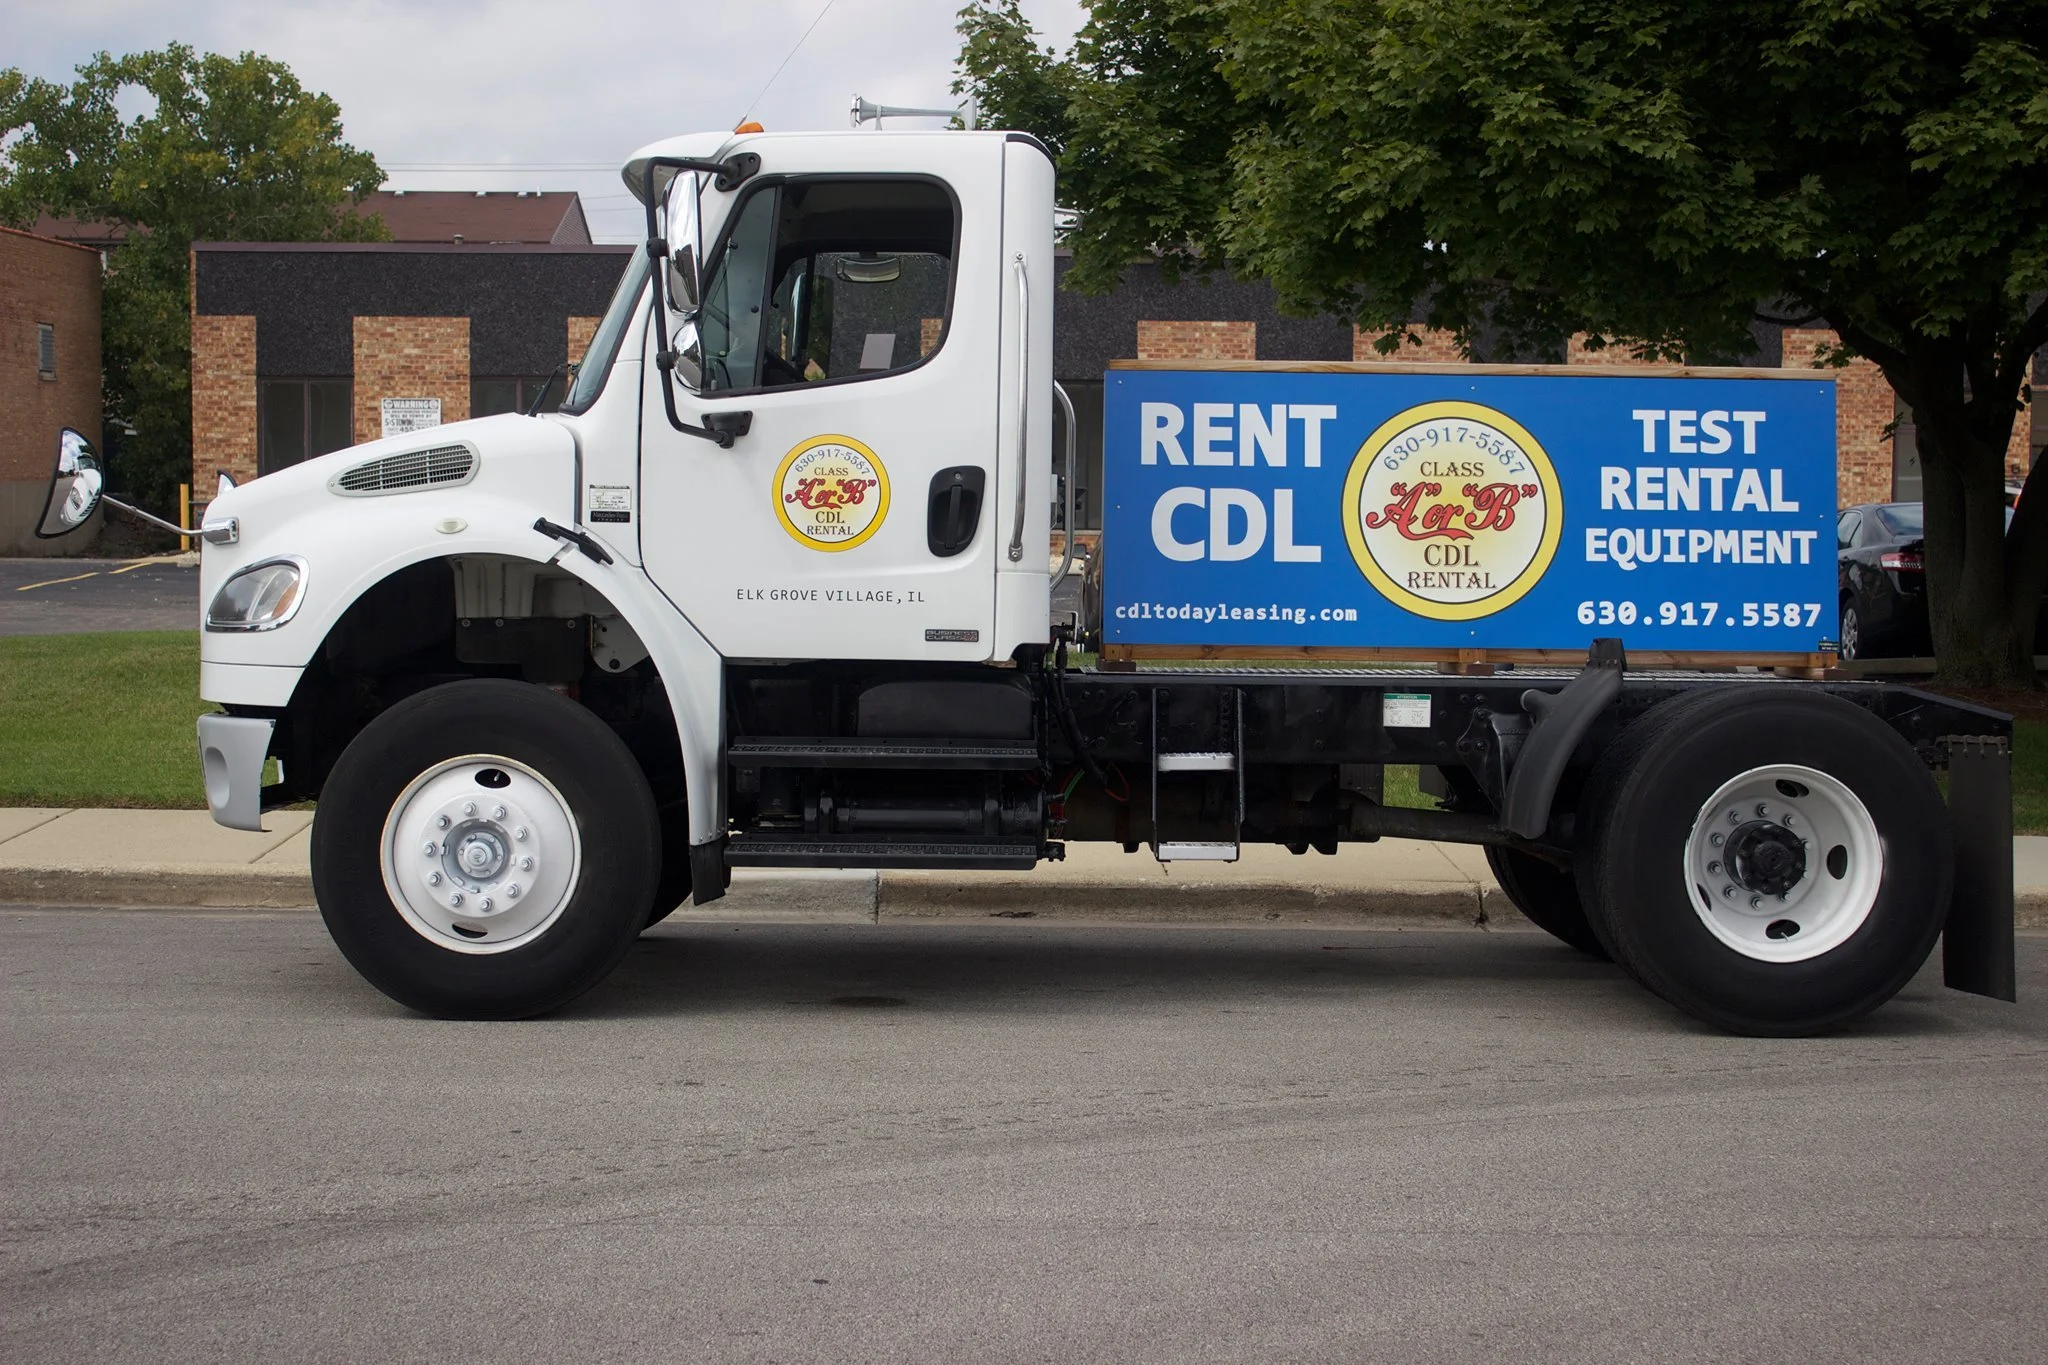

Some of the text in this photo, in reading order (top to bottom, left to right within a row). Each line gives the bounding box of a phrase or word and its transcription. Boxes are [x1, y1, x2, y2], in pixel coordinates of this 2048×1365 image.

[394, 401, 429, 409] WARNING
[1140, 402, 1337, 467] RENT
[1632, 409, 1766, 454] TEST
[795, 448, 871, 475] 630-917-5587
[1383, 426, 1526, 476] 630-917-5587
[813, 467, 849, 476] CLASS
[1420, 461, 1485, 478] CLASS
[1601, 466, 1799, 513] RENTAL
[815, 510, 845, 524] CDL
[1151, 486, 1322, 562] CDL
[1421, 503, 1464, 530] or
[806, 525, 854, 535] RENTAL
[1423, 544, 1479, 567] CDL
[1585, 527, 1818, 571] EQUIPMENT
[1407, 571, 1496, 589] RENTAL
[737, 588, 764, 600] ELK
[770, 589, 818, 601] GROVE
[908, 591, 925, 603] IL
[1115, 602, 1358, 625] cdltodayleasing.com
[1577, 600, 1822, 627] 630.917.5587
